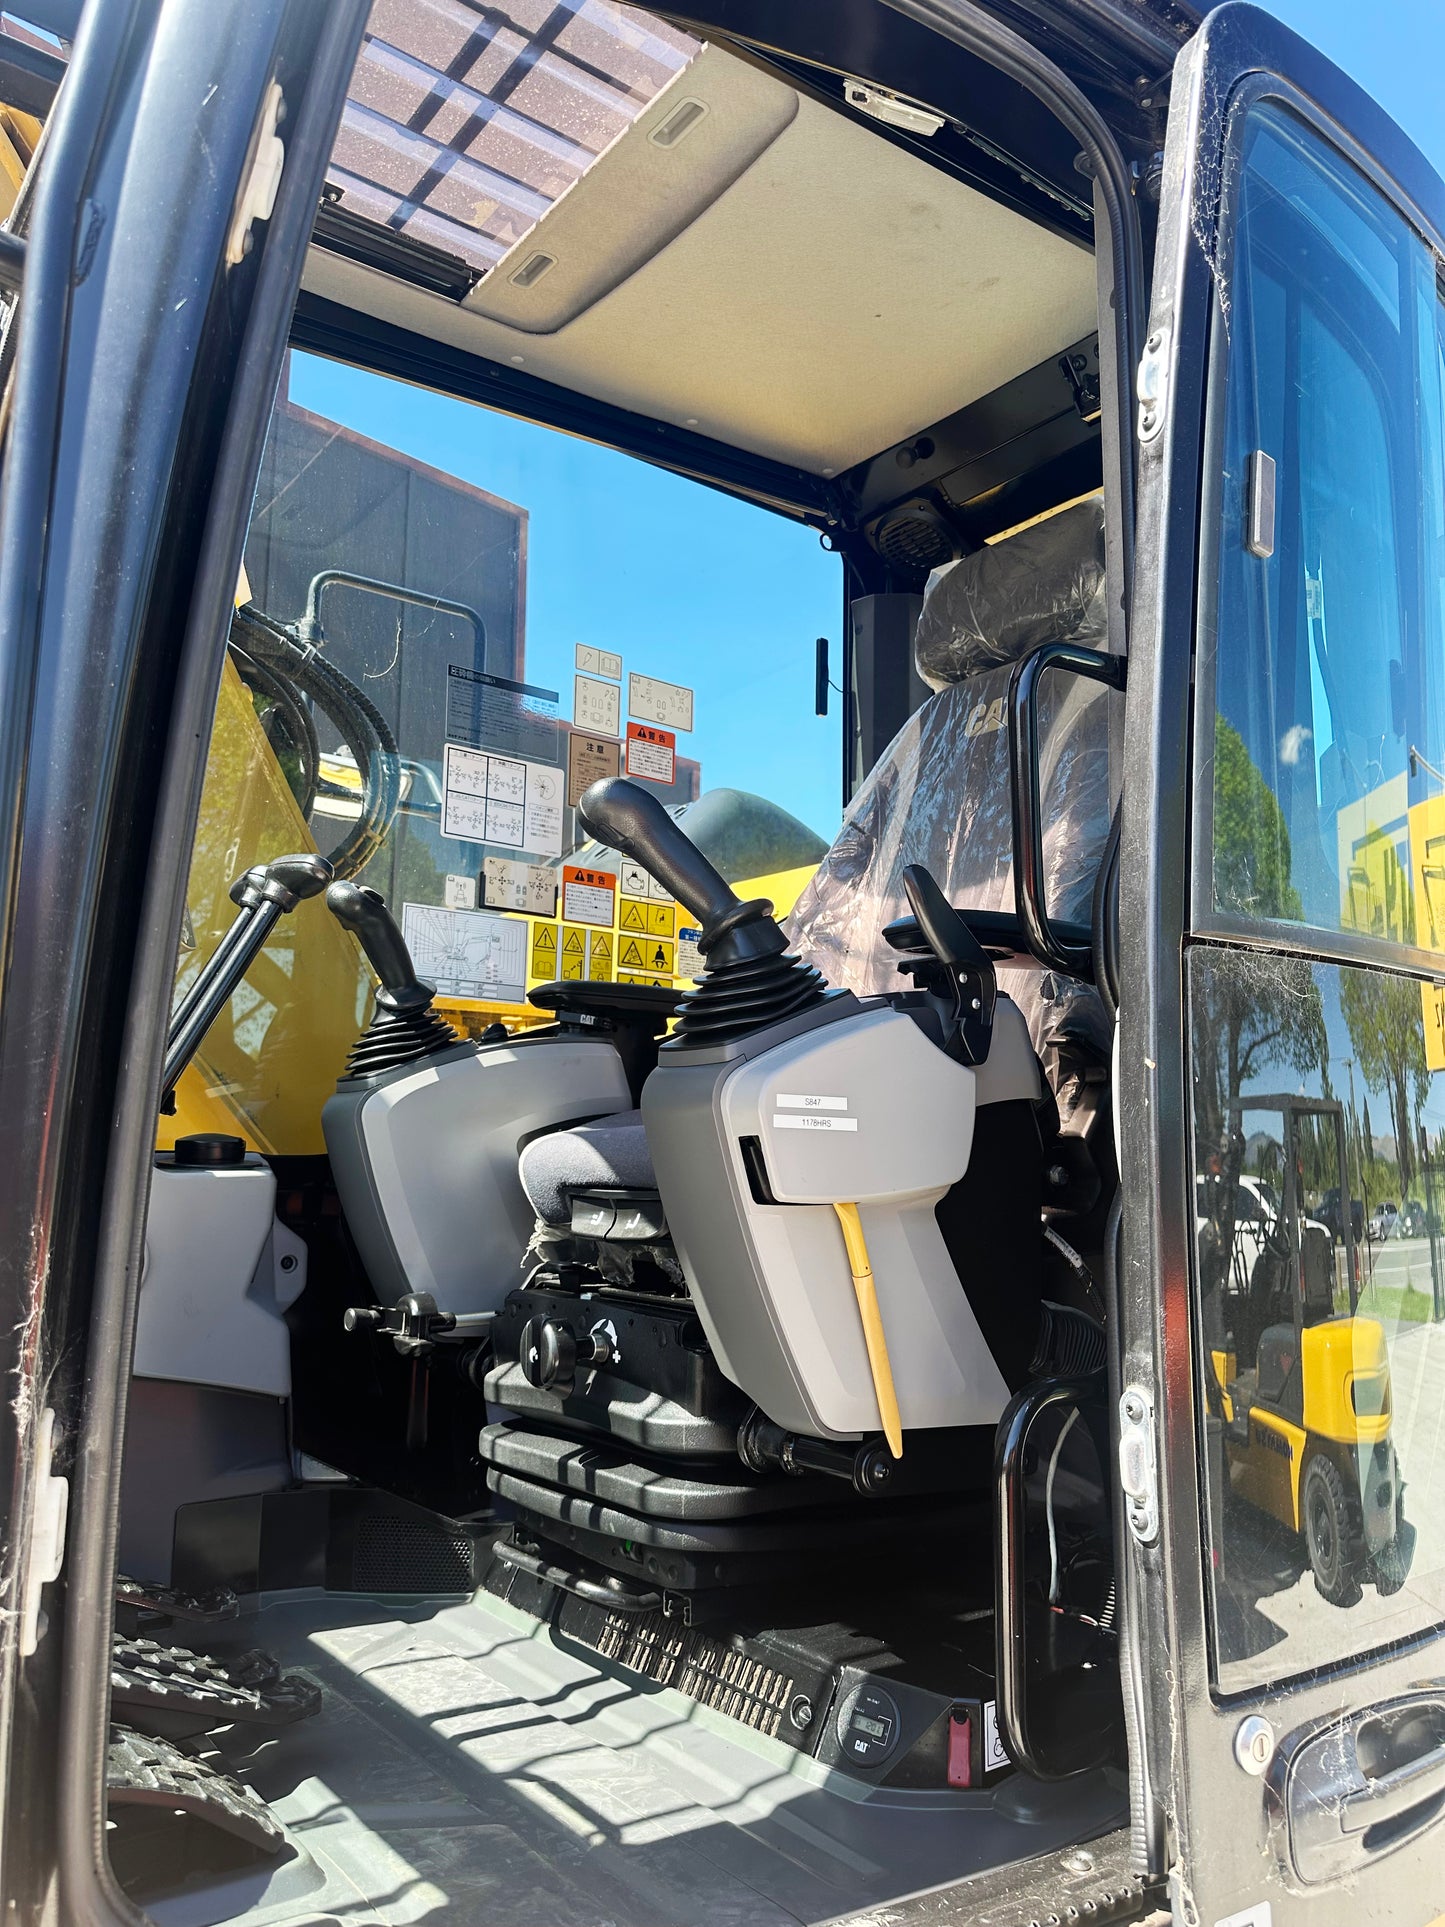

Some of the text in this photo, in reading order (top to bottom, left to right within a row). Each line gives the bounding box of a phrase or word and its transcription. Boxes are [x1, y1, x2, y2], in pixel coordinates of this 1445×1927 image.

[964, 697, 1008, 737] CA
[648, 731, 666, 743] 警告
[586, 742, 604, 754] 注意
[586, 873, 605, 885] 警告
[580, 1014, 595, 1026] CAT
[804, 1097, 821, 1106] S847
[802, 1119, 832, 1128] 1178HRS
[854, 1739, 869, 1753] CAT
